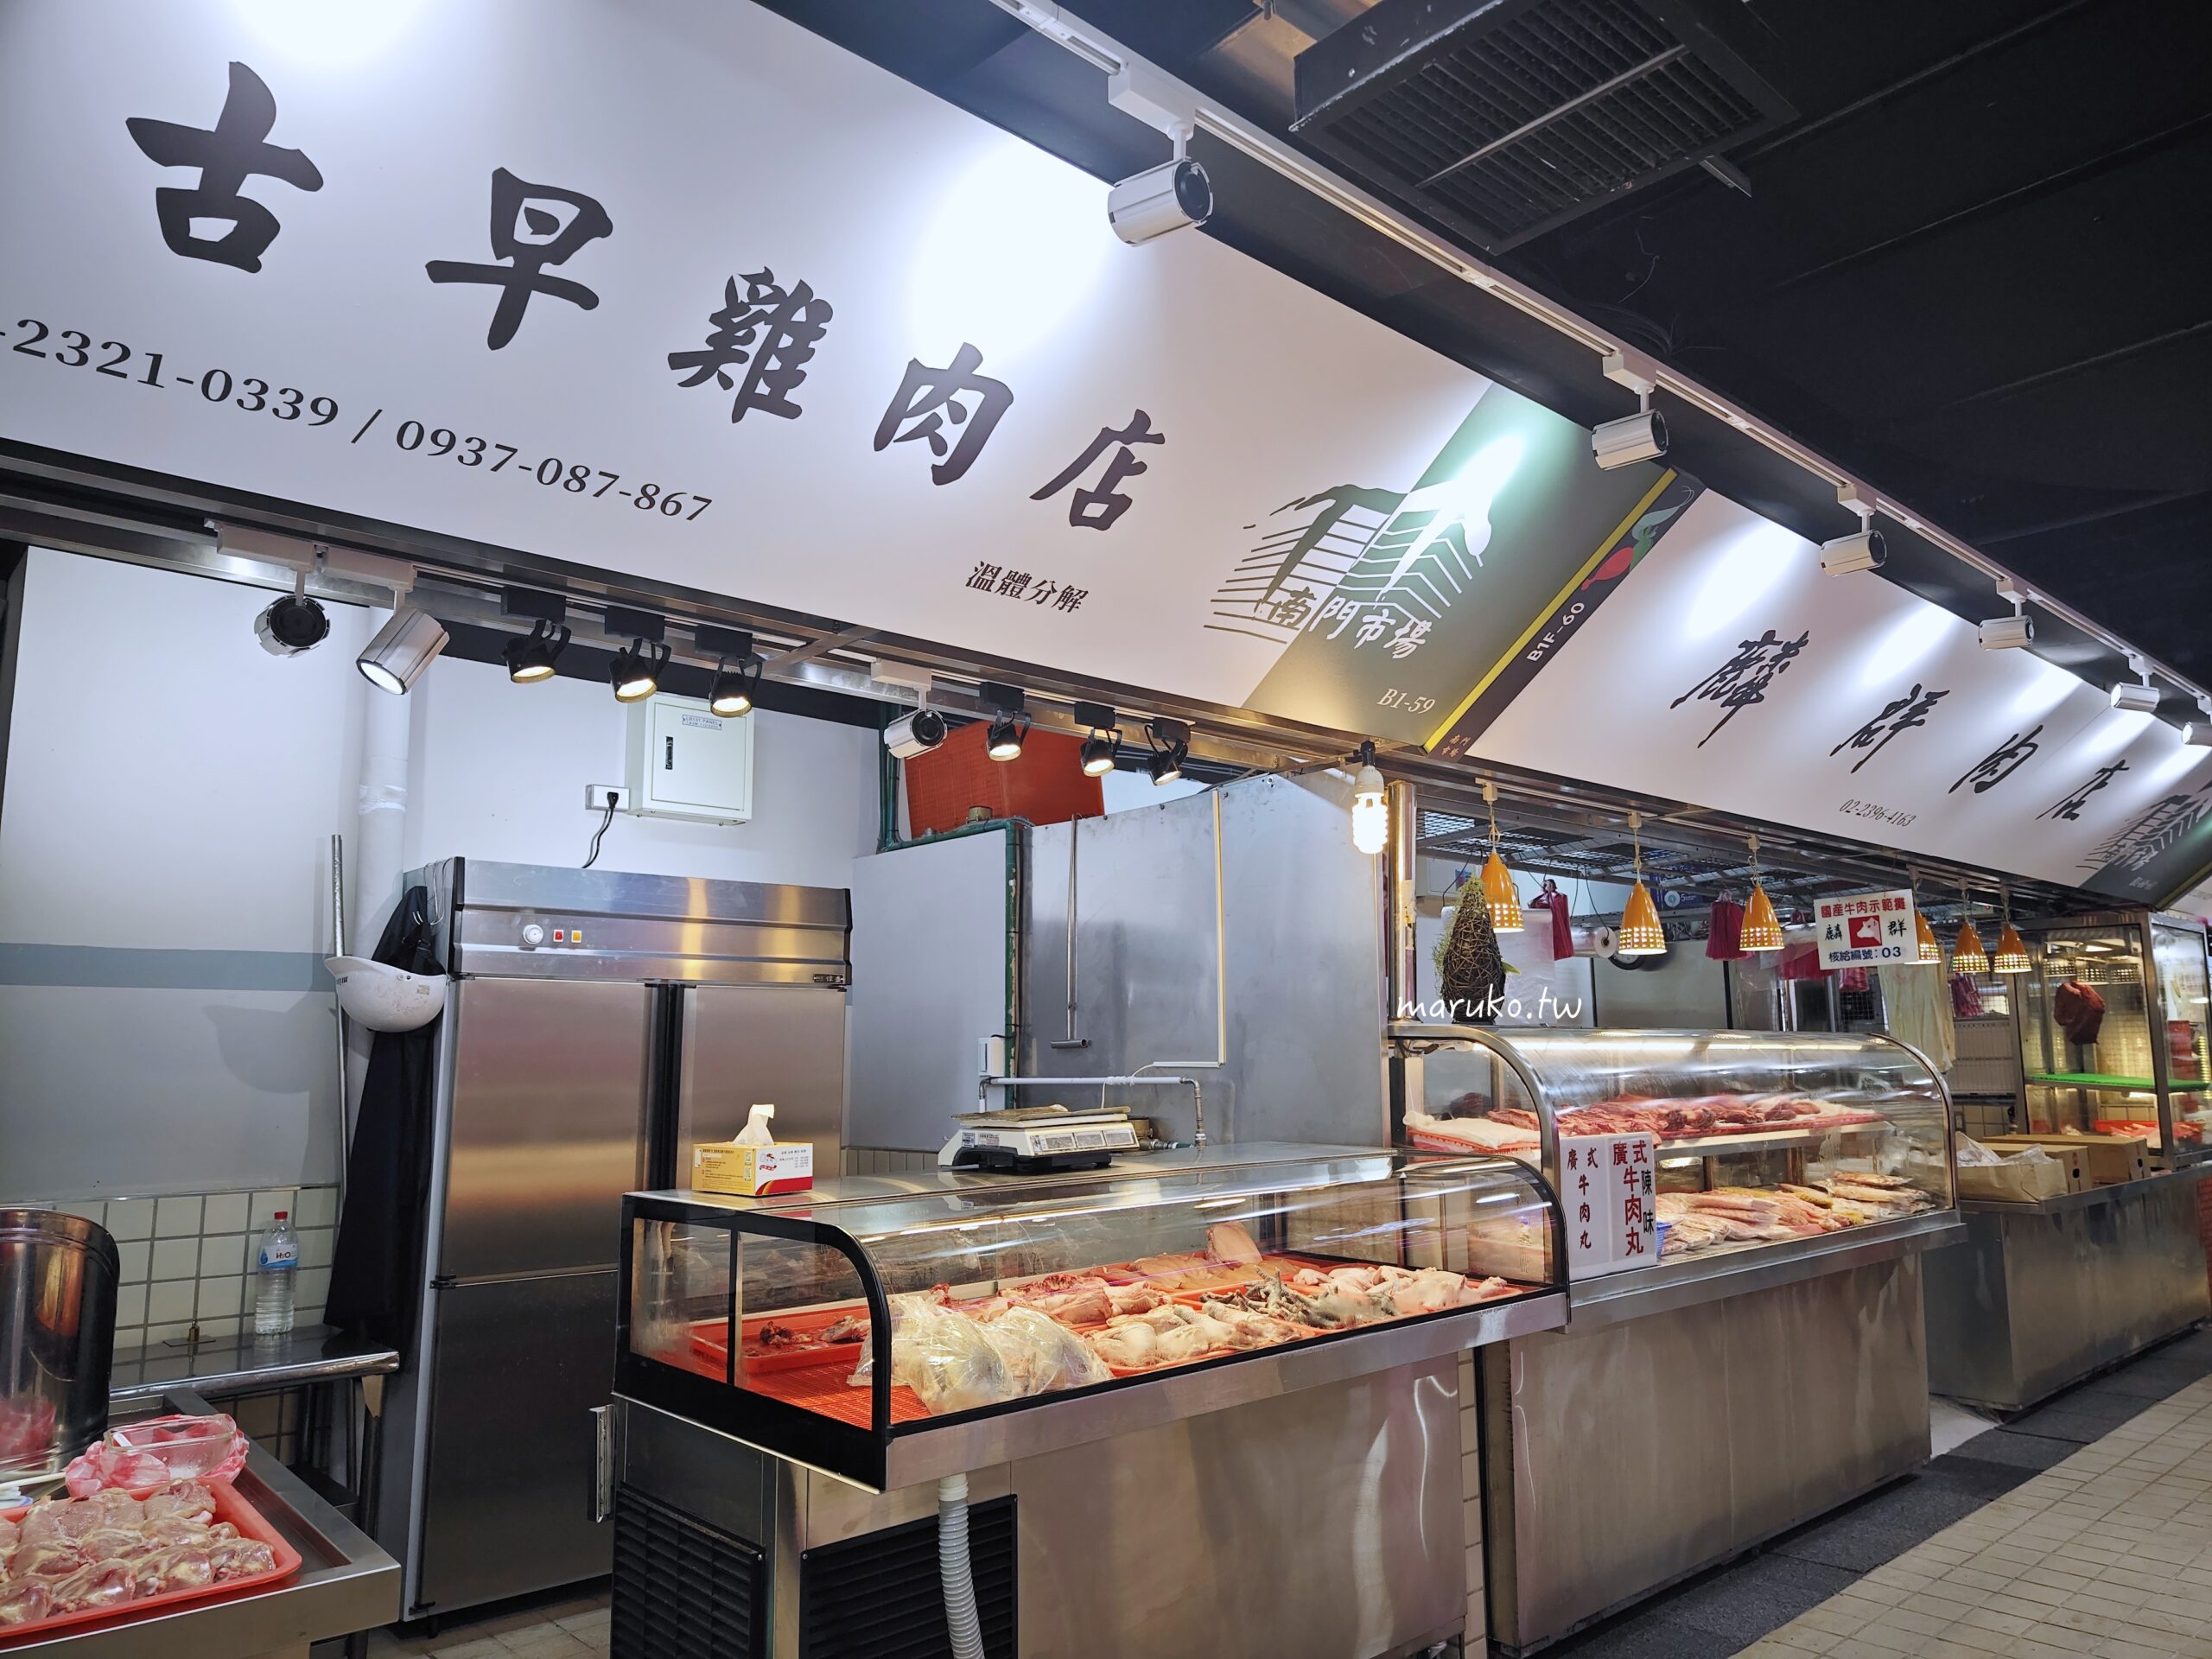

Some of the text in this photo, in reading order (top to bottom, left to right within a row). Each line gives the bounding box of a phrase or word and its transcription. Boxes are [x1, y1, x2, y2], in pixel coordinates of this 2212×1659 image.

[126, 61, 1165, 531] 古早雞肉店
[396, 420, 712, 522] 0937-087-867
[965, 560, 1089, 613] 溫體分解
[1526, 602, 1585, 662] B1F-60
[1376, 689, 1436, 715] B1-59
[1839, 798, 1916, 827] 02-2396-4163
[1887, 919, 1906, 937] 群
